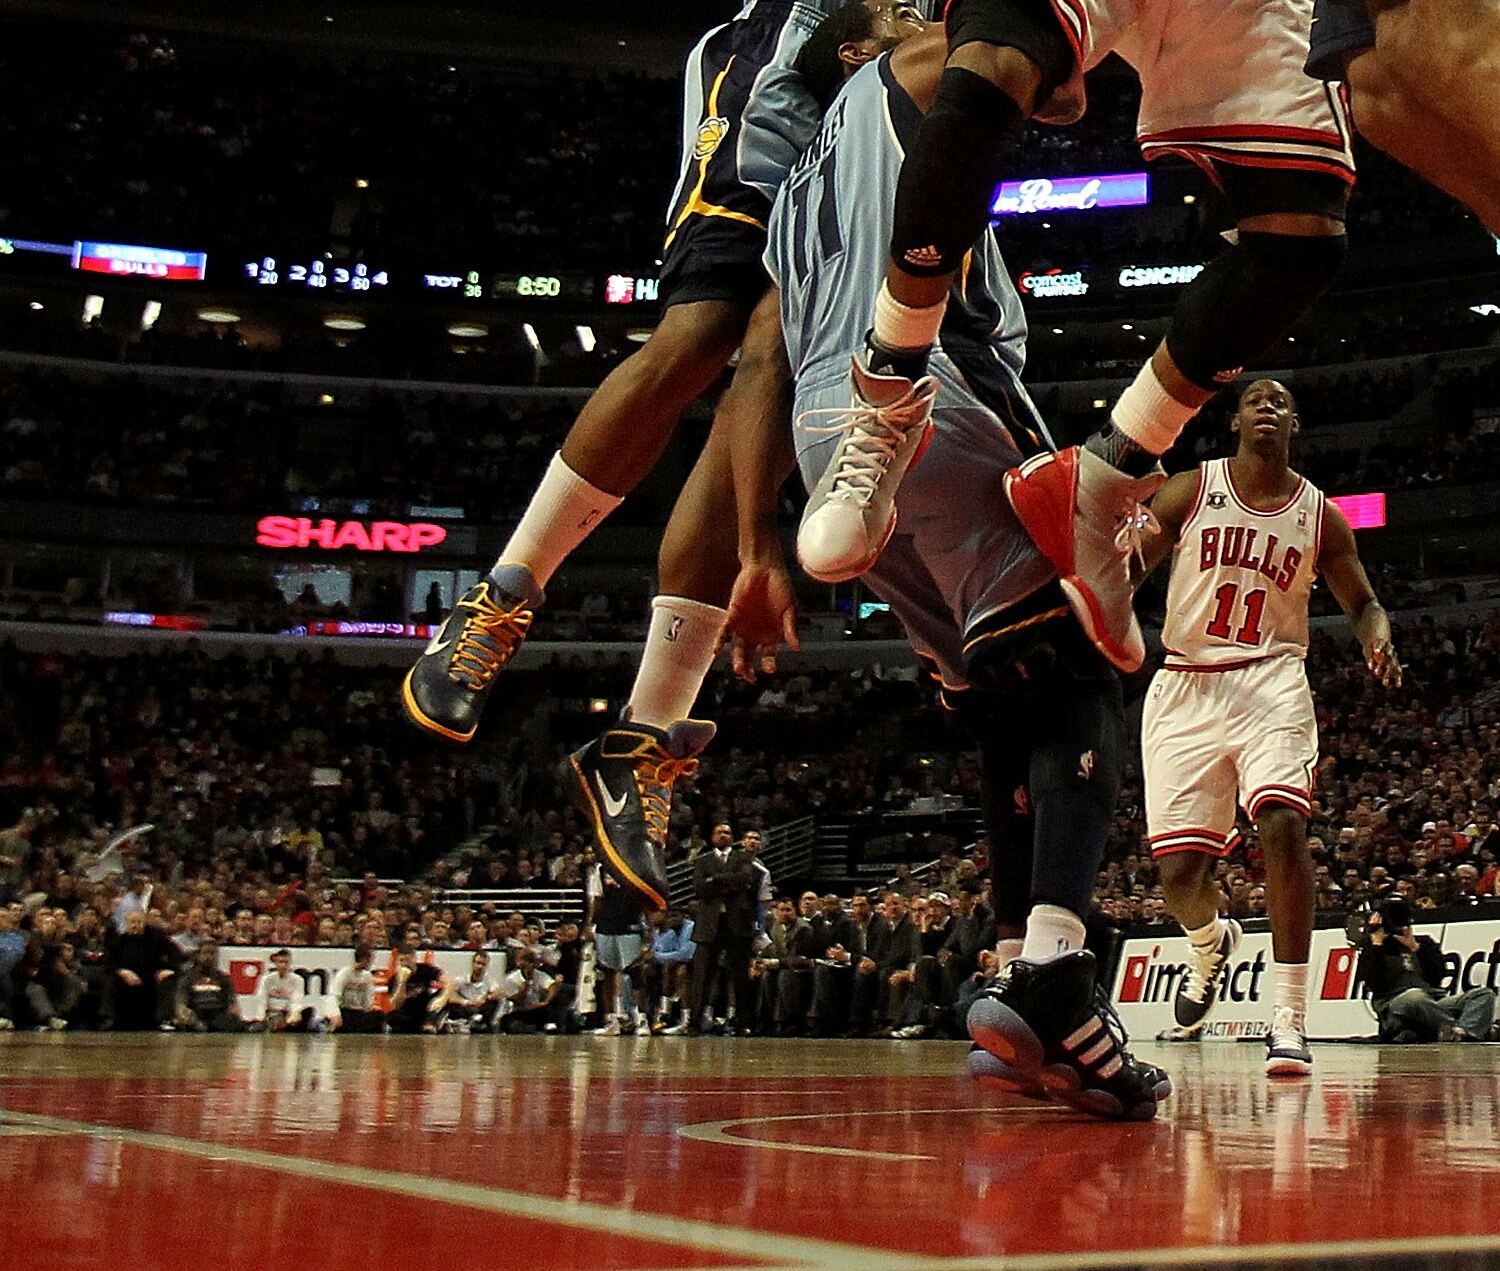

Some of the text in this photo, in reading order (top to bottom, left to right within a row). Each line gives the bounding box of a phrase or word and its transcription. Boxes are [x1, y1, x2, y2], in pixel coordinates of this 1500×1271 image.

[288, 265, 307, 281] 2
[334, 267, 350, 283] 3
[423, 274, 464, 289] TOT
[467, 271, 480, 284] 0
[516, 276, 560, 296] 8:50
[256, 516, 447, 552] SHARP
[1201, 526, 1302, 592] BULLS
[1206, 583, 1267, 646] 11
